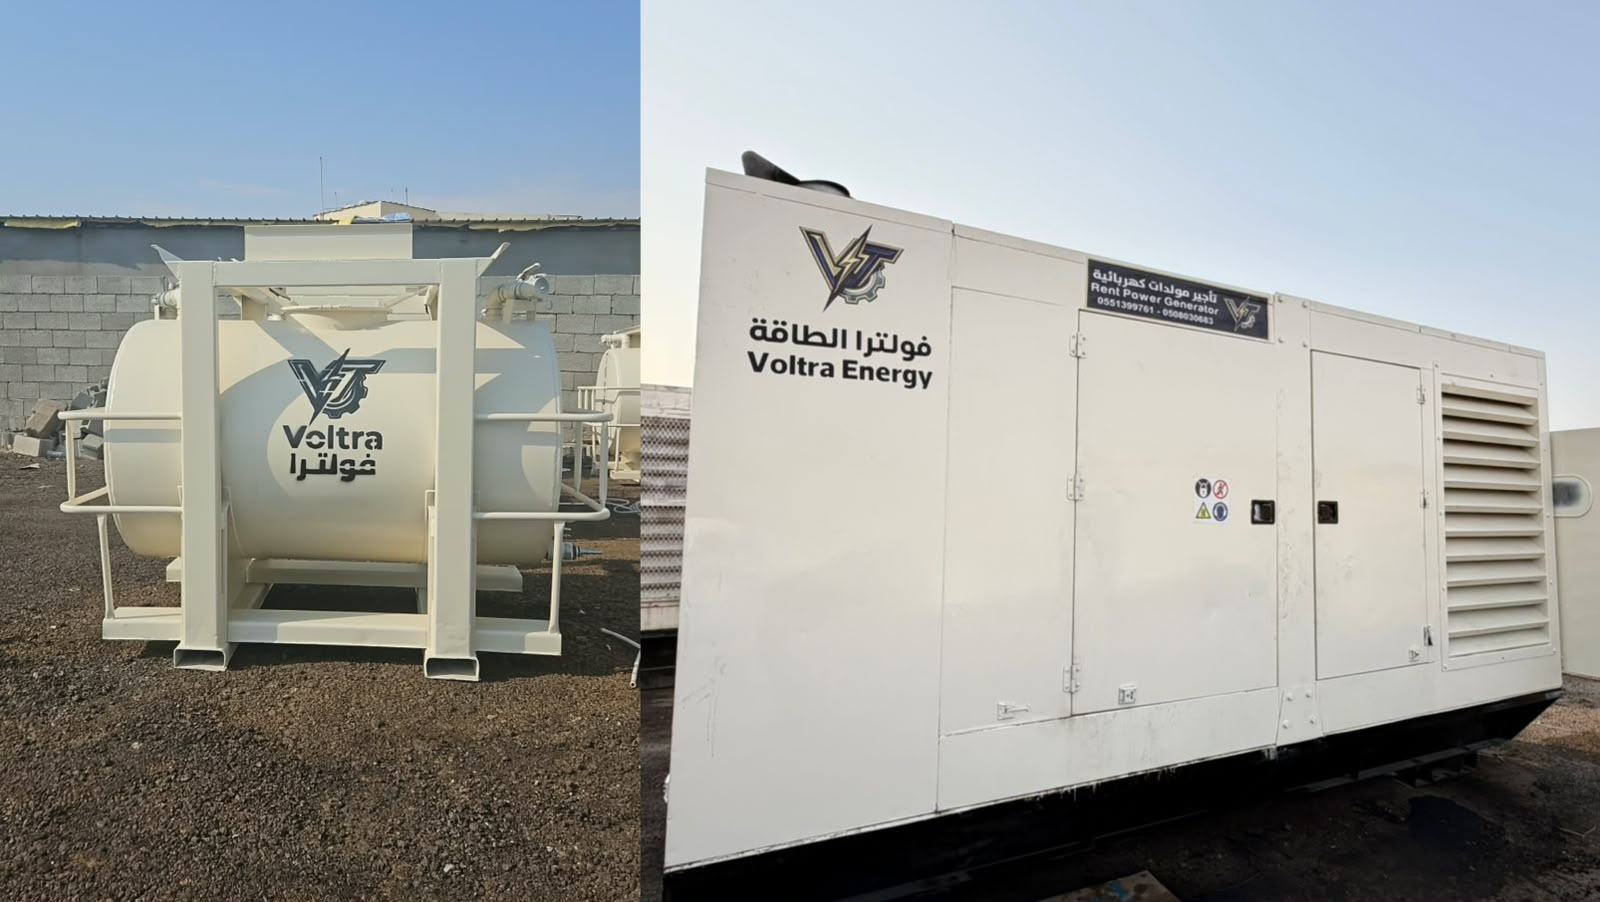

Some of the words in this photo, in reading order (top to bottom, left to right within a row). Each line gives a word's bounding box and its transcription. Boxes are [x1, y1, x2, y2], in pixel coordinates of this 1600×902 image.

[1093, 269, 1145, 289] كهربائية
[1149, 281, 1190, 298] مولدات
[1091, 282, 1120, 296] Rent
[1123, 290, 1162, 304] Power
[1164, 297, 1219, 315] Generator
[1192, 291, 1218, 304] تأجير
[749, 317, 847, 349] الطاقة
[856, 331, 932, 361] فولترا
[747, 351, 835, 378] Voltra
[842, 360, 933, 389] Energy
[283, 425, 383, 450] Voltra
[290, 453, 376, 482] فولترا
